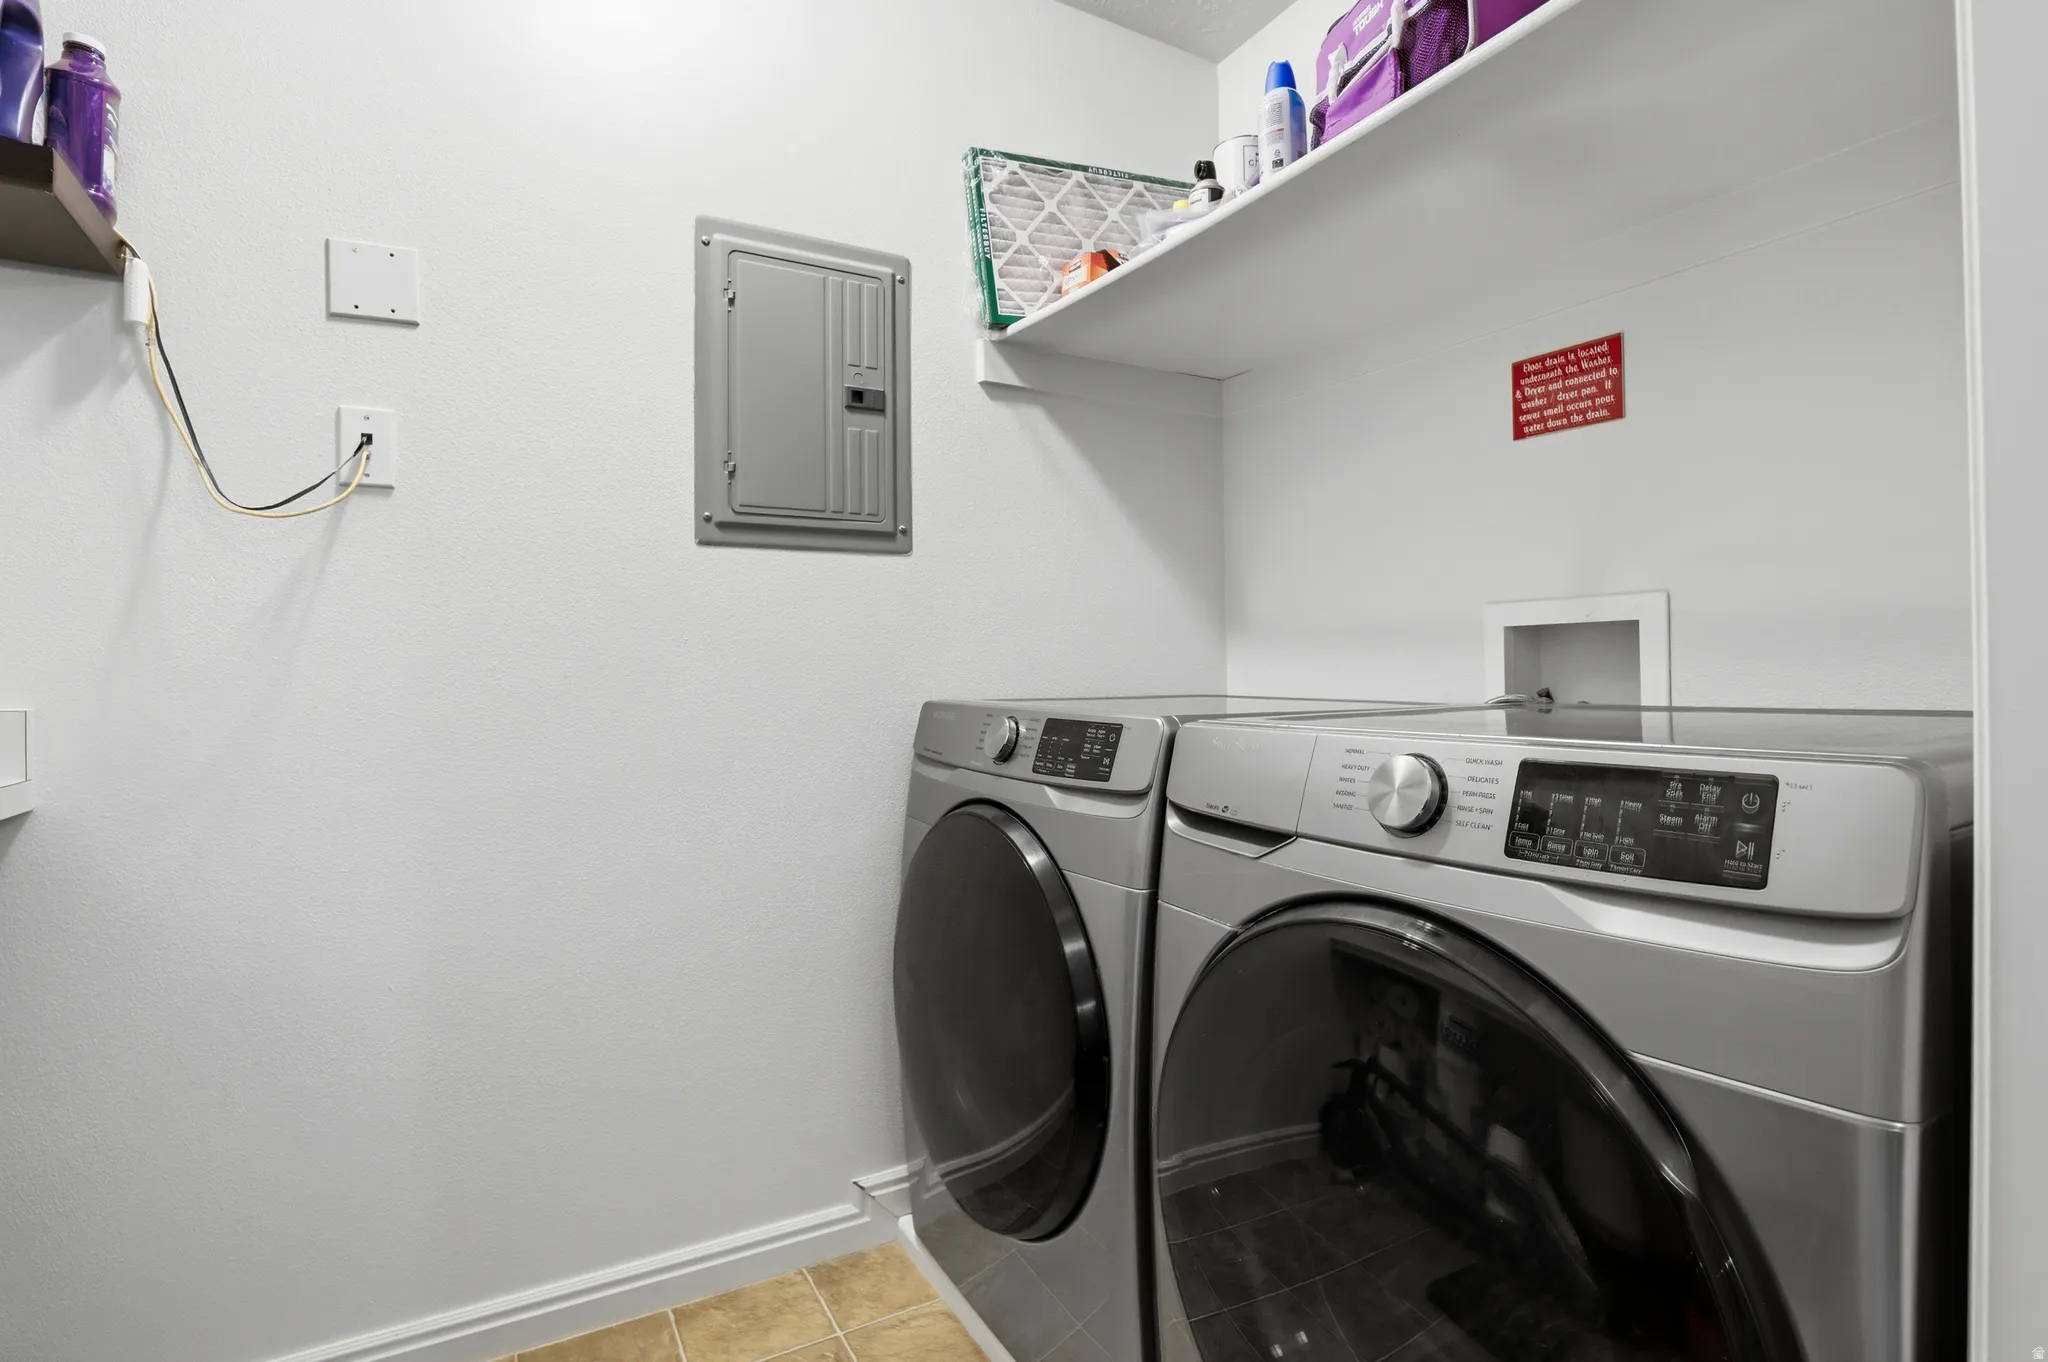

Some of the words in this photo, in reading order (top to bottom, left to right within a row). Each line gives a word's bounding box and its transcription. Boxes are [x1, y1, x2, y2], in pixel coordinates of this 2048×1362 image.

[1353, 0, 1383, 36] TOUGH
[980, 207, 992, 259] FILTERBUY
[1523, 362, 1543, 373] Floor
[1545, 356, 1565, 367] drain
[1568, 351, 1575, 360] is
[1577, 341, 1610, 358] located
[1520, 368, 1563, 385] underneath
[1565, 364, 1579, 374] the
[1581, 355, 1612, 370] Washer
[1515, 389, 1522, 399] &
[1524, 385, 1545, 397] Dryer
[1548, 380, 1563, 391] and
[1565, 370, 1606, 387] connected
[1609, 367, 1618, 376] to
[1521, 397, 1547, 409] washer
[1557, 390, 1578, 401] dryer
[1581, 385, 1598, 397] pan.
[1519, 411, 1540, 422] sewer
[1543, 405, 1564, 417] smell
[1566, 399, 1592, 411] occurs
[1595, 394, 1615, 406] pour
[1523, 422, 1544, 433] water
[1547, 418, 1567, 429] down
[1570, 412, 1584, 423] the
[1586, 408, 1610, 420] drain.
[1467, 775, 1499, 785] DELICATES
[1700, 783, 1722, 795] Delay
[1701, 792, 1717, 802] End
[1479, 807, 1494, 815] SPIN
[1455, 820, 1469, 828] SELF
[1659, 813, 1683, 825] Steam
[1694, 813, 1718, 825] Alarm
[1698, 823, 1713, 834] Off
[1583, 847, 1599, 857] Spin
[1620, 852, 1635, 861] Soil
